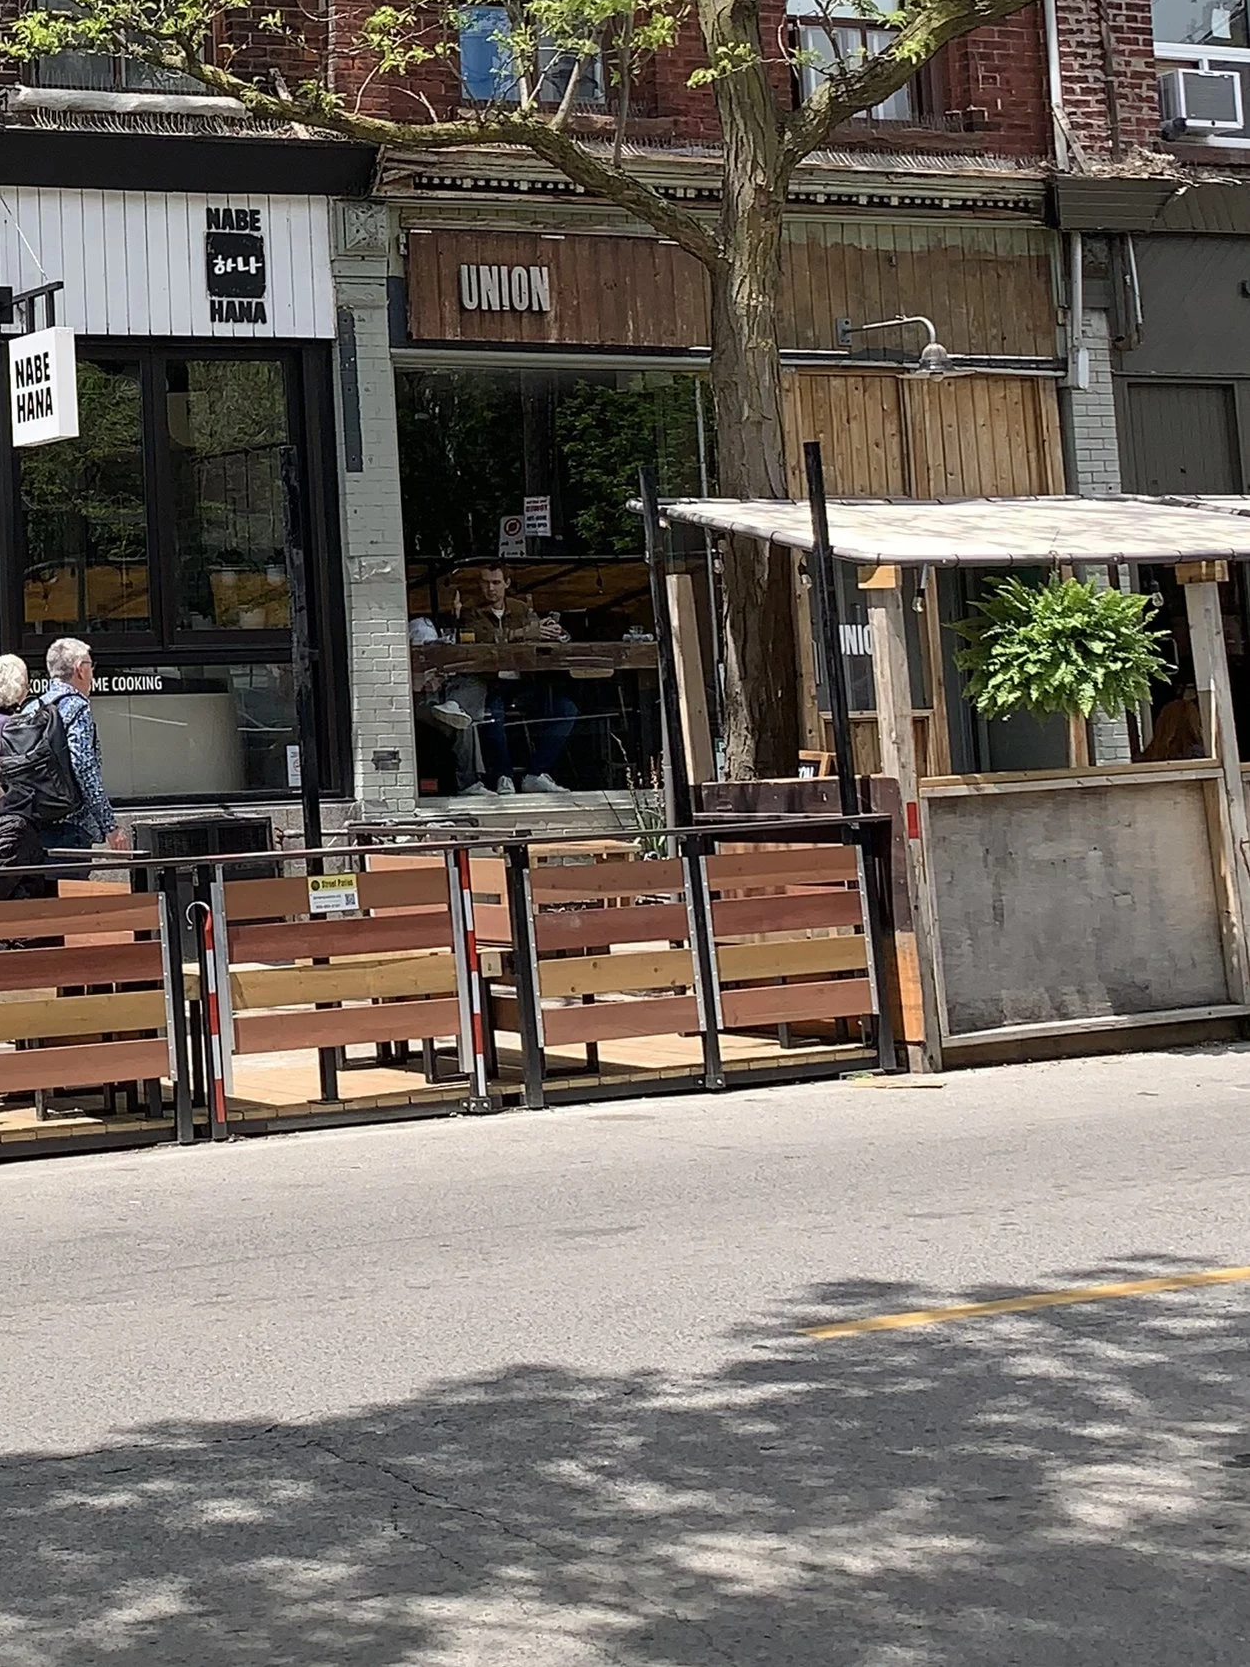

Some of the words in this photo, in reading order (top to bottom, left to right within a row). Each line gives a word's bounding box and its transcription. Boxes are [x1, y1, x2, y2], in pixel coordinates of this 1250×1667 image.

[206, 207, 262, 232] NABE
[212, 254, 263, 275] 하나
[460, 264, 551, 312] UNION
[210, 300, 267, 324] HANA
[14, 351, 51, 390] NABE
[16, 386, 54, 424] HANA
[91, 677, 110, 692] ME
[112, 675, 163, 692] COOKING
